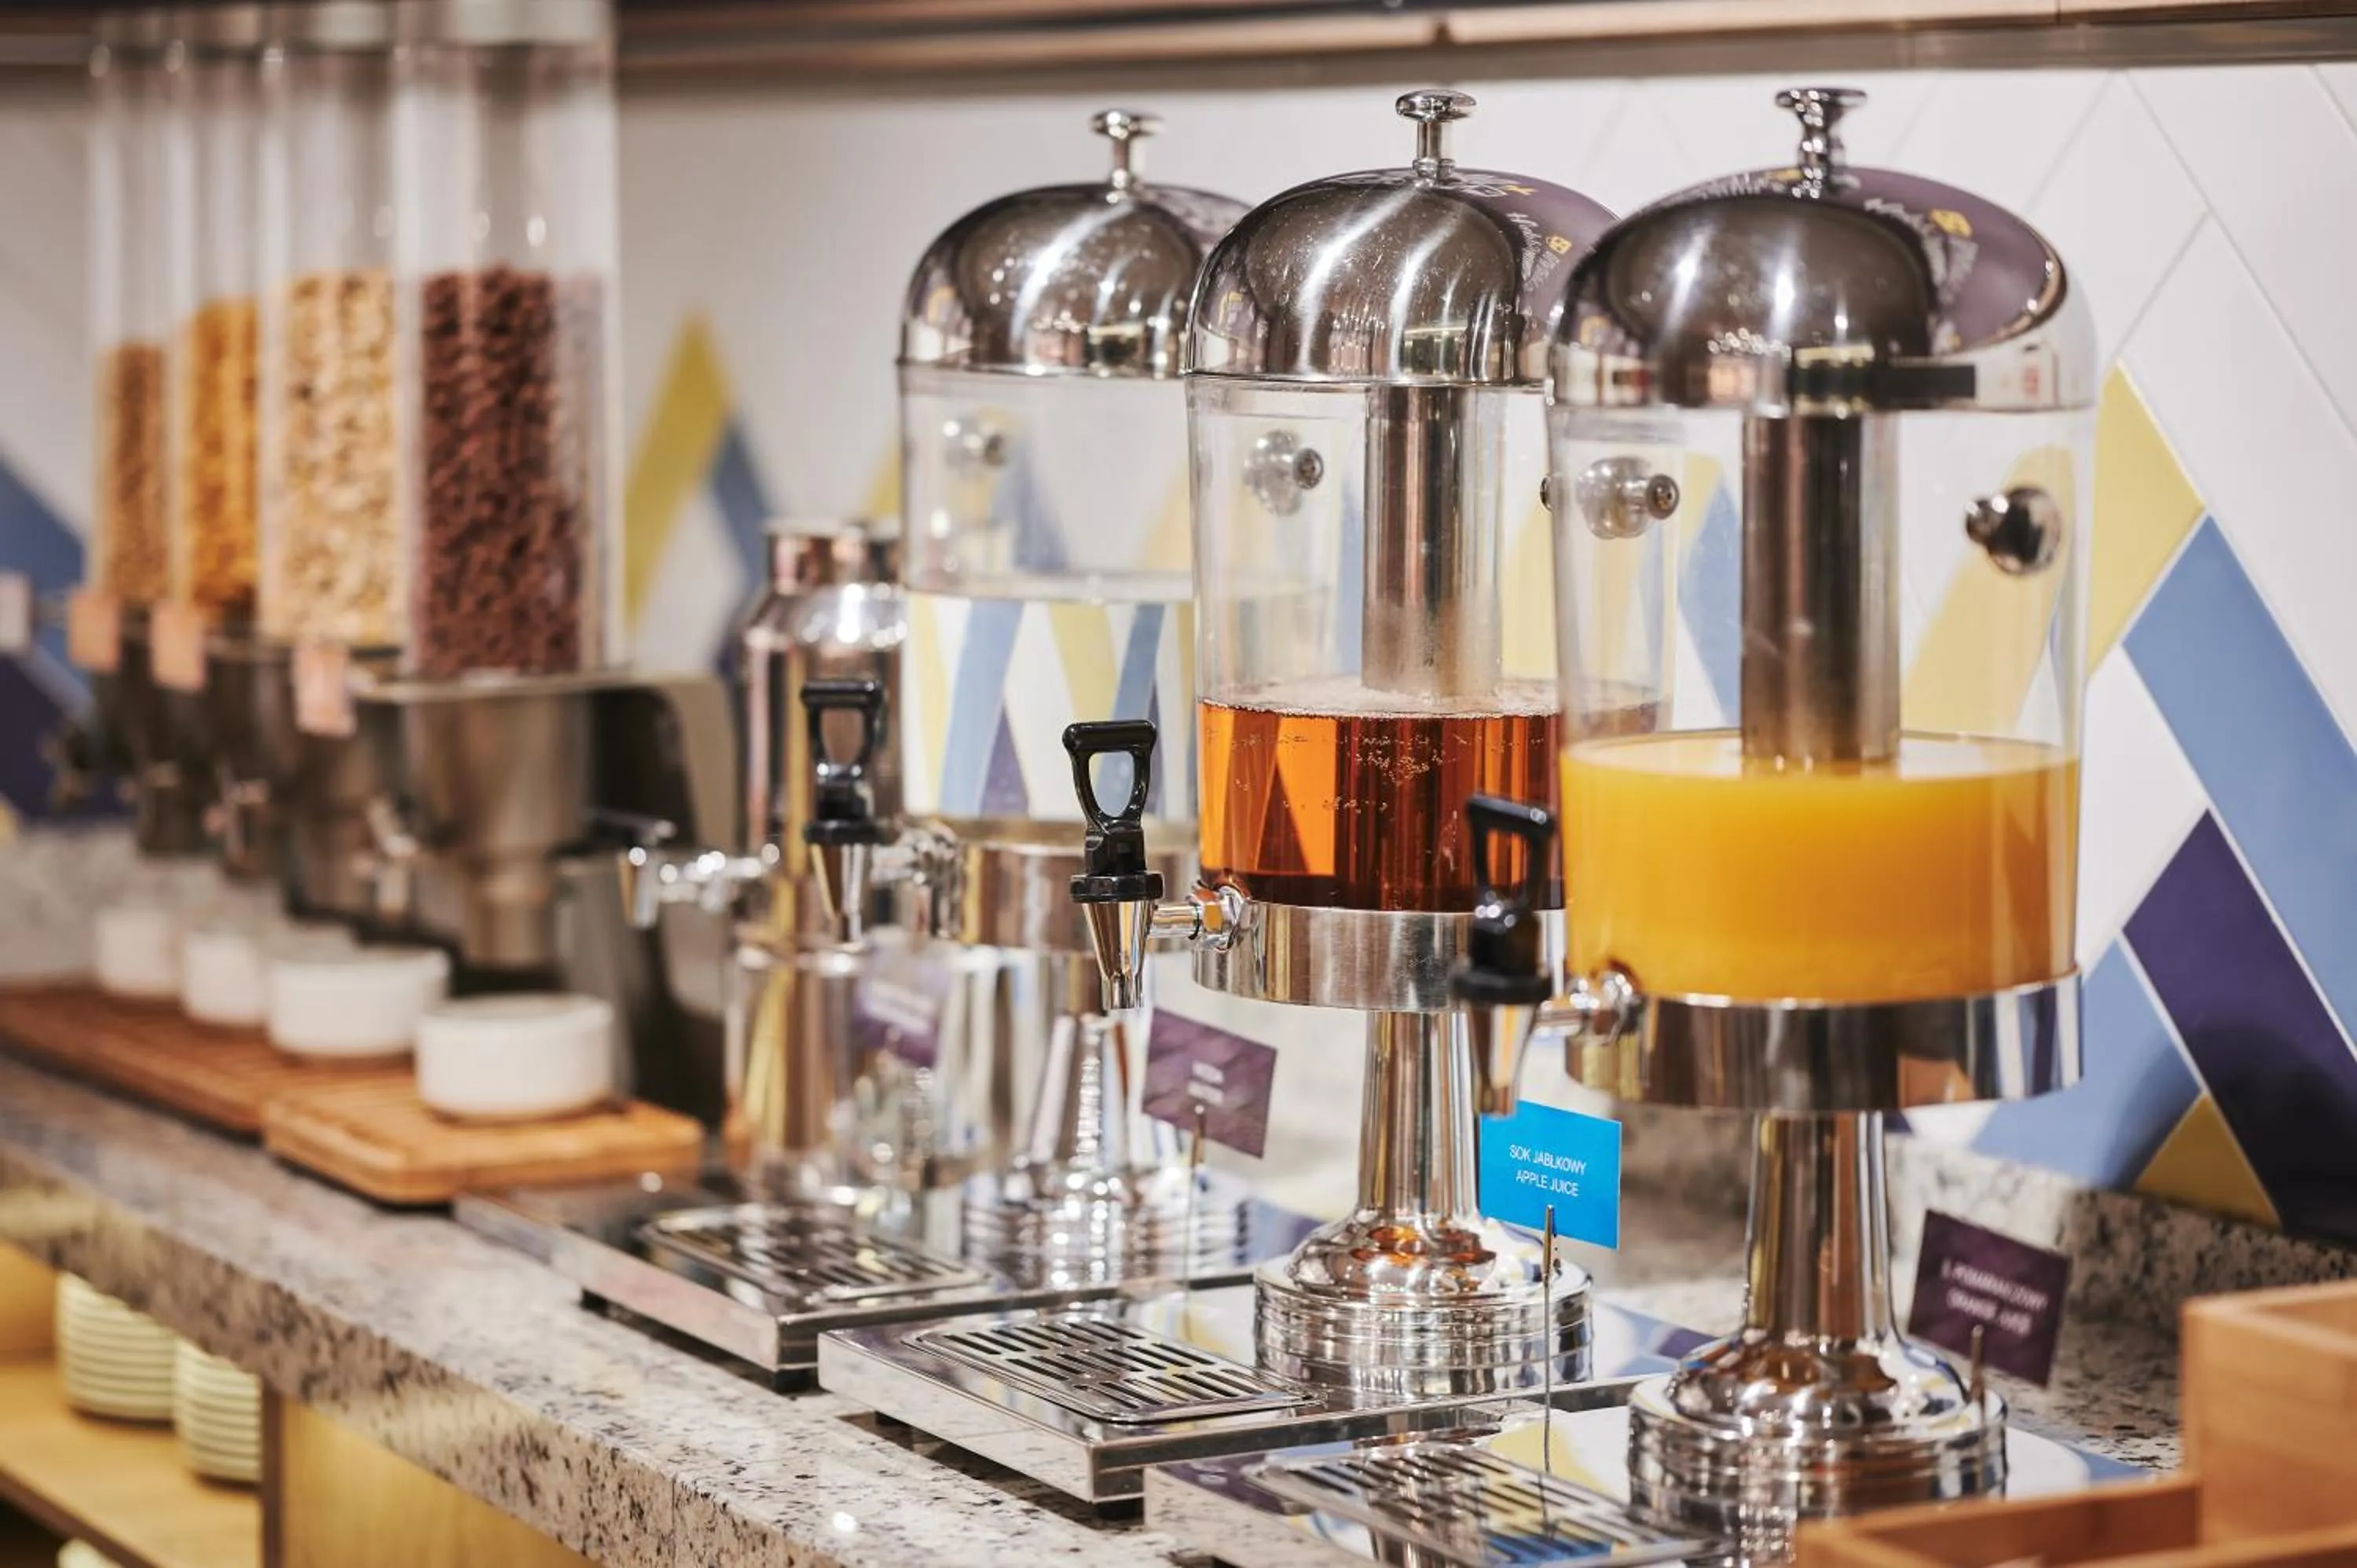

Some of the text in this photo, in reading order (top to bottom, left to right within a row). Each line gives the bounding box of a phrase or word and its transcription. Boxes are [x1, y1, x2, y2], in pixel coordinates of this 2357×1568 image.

[1509, 1144, 1530, 1162] SOK
[1516, 1169, 1578, 1196] APPLE JUICE
